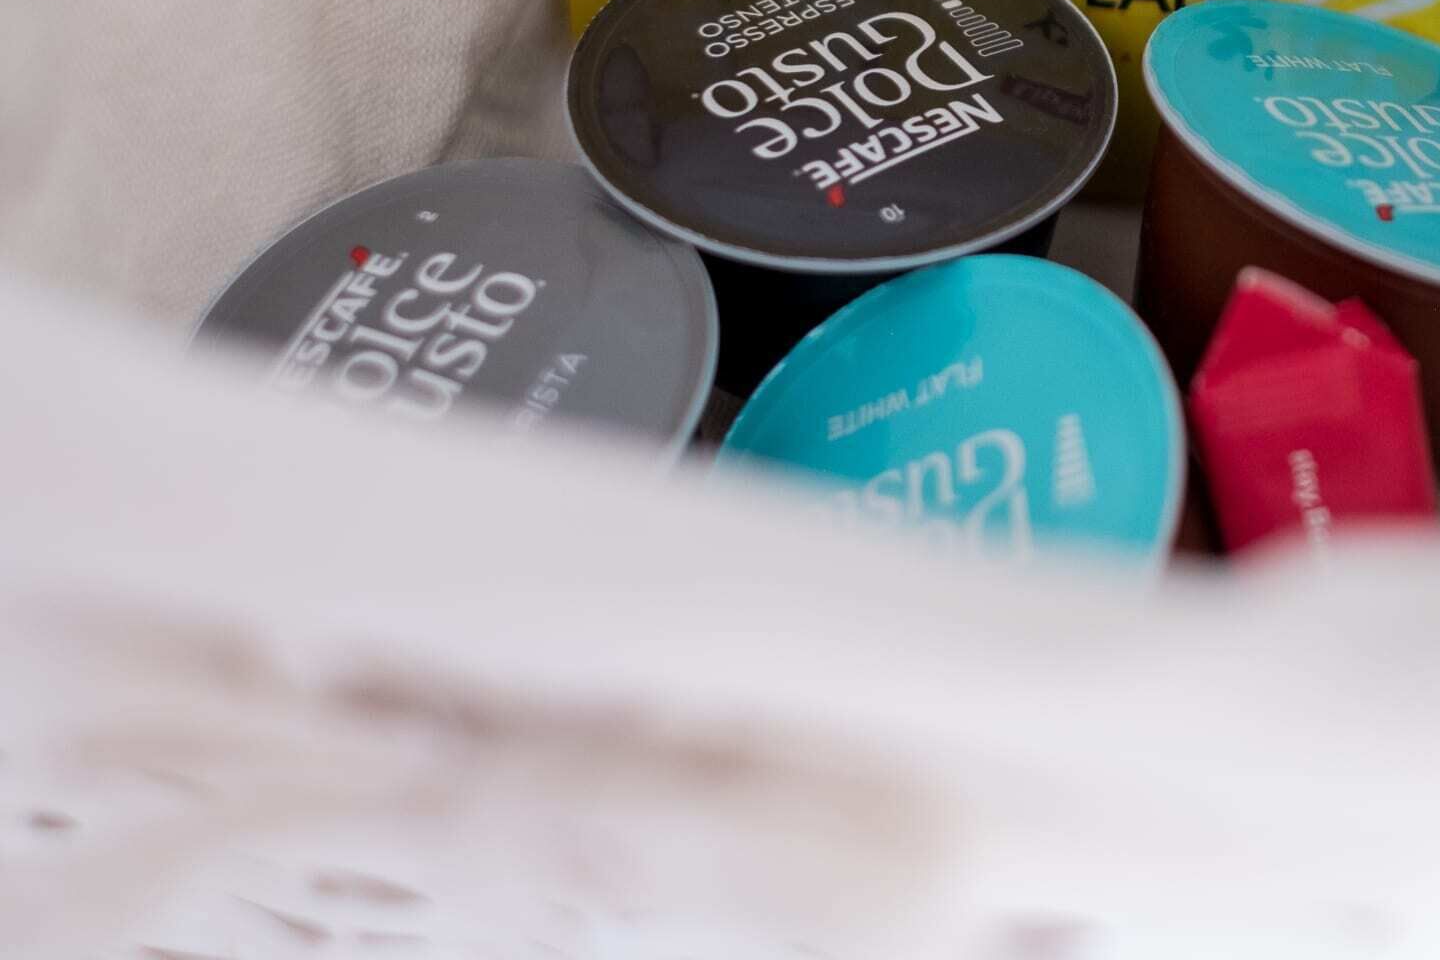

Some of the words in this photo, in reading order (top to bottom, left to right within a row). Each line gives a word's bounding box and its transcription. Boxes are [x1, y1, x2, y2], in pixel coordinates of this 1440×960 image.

[701, 11, 936, 118] Gusto
[1246, 54, 1330, 71] WHITE
[1338, 58, 1393, 78] FLAT
[734, 41, 994, 159] Dolce
[879, 203, 905, 223] 10
[340, 252, 484, 400] olce
[384, 271, 537, 420] usto
[915, 354, 984, 407] FLAT
[827, 388, 911, 442] WHITE
